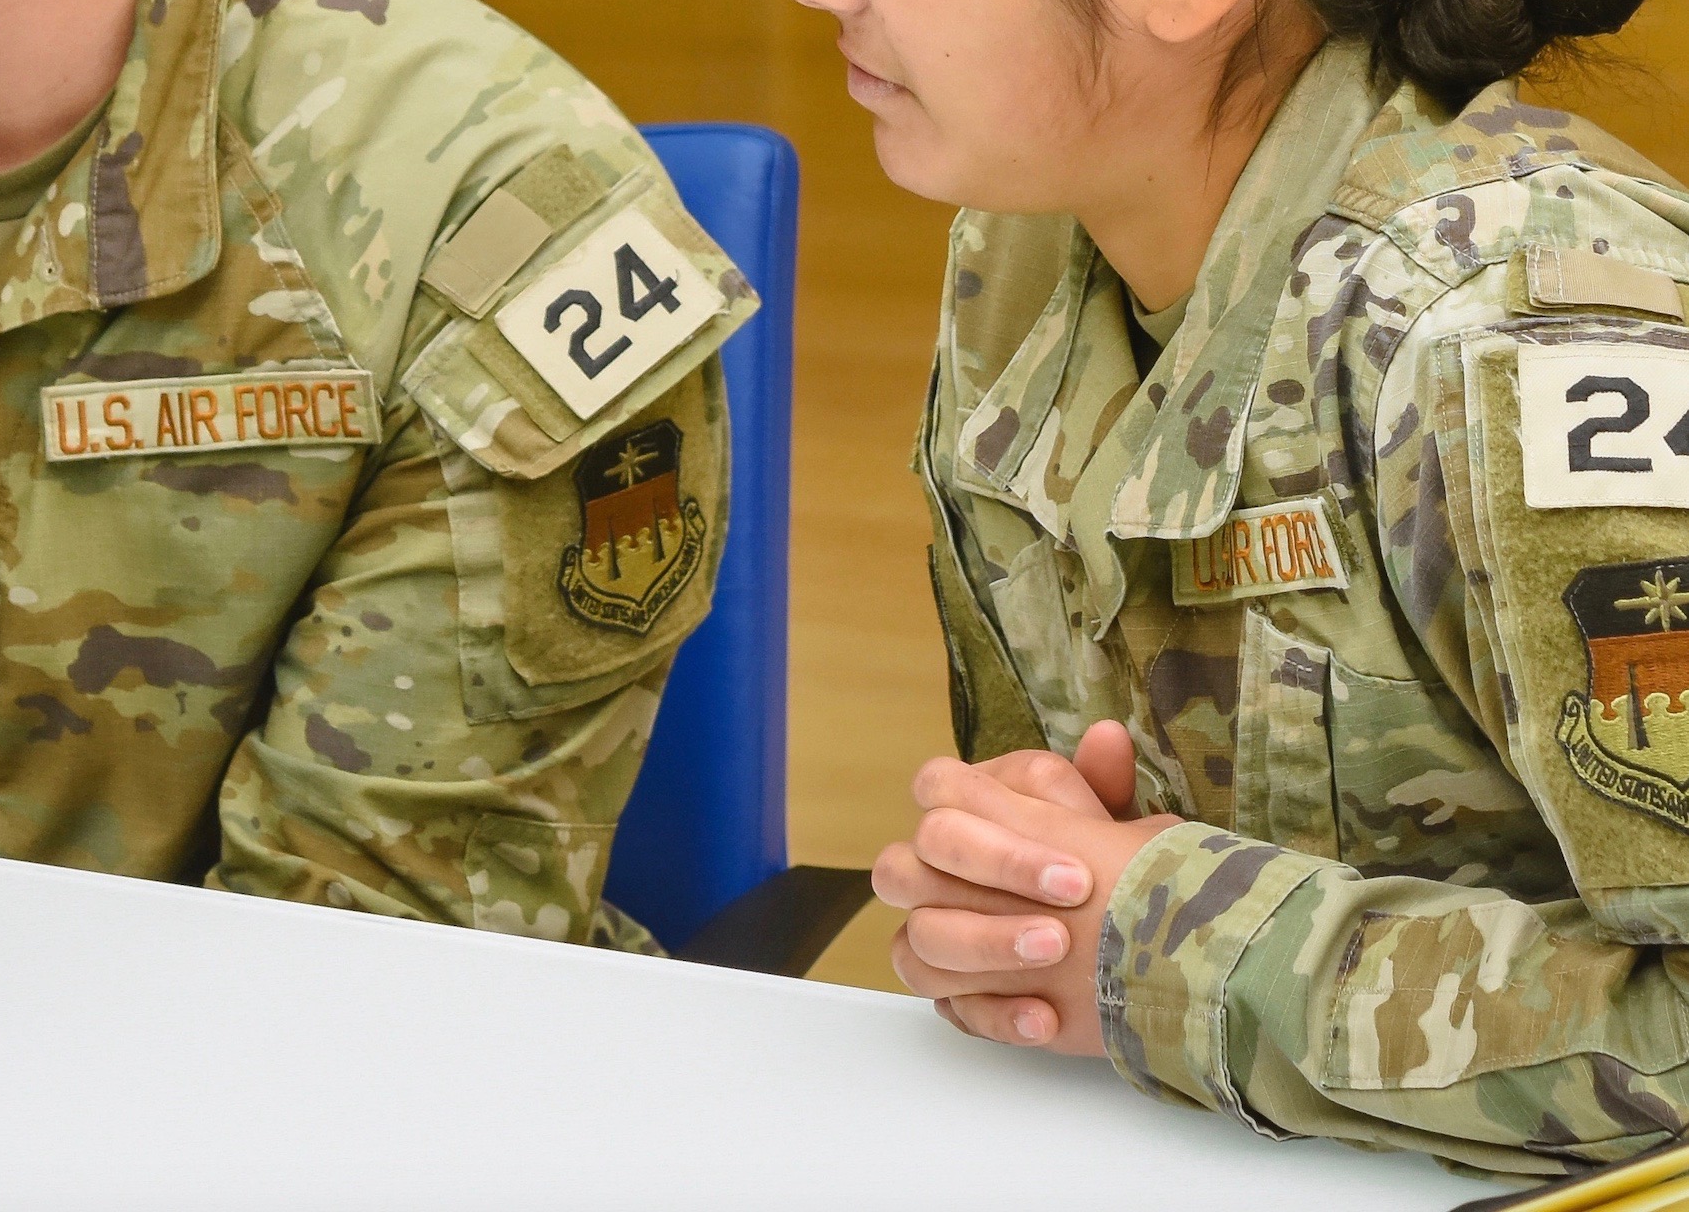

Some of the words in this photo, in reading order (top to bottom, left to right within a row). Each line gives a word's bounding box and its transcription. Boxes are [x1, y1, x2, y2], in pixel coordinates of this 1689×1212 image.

[543, 242, 681, 380] 24
[56, 394, 144, 455] U.S.
[157, 388, 222, 446] AIR
[233, 383, 362, 440] FORCE
